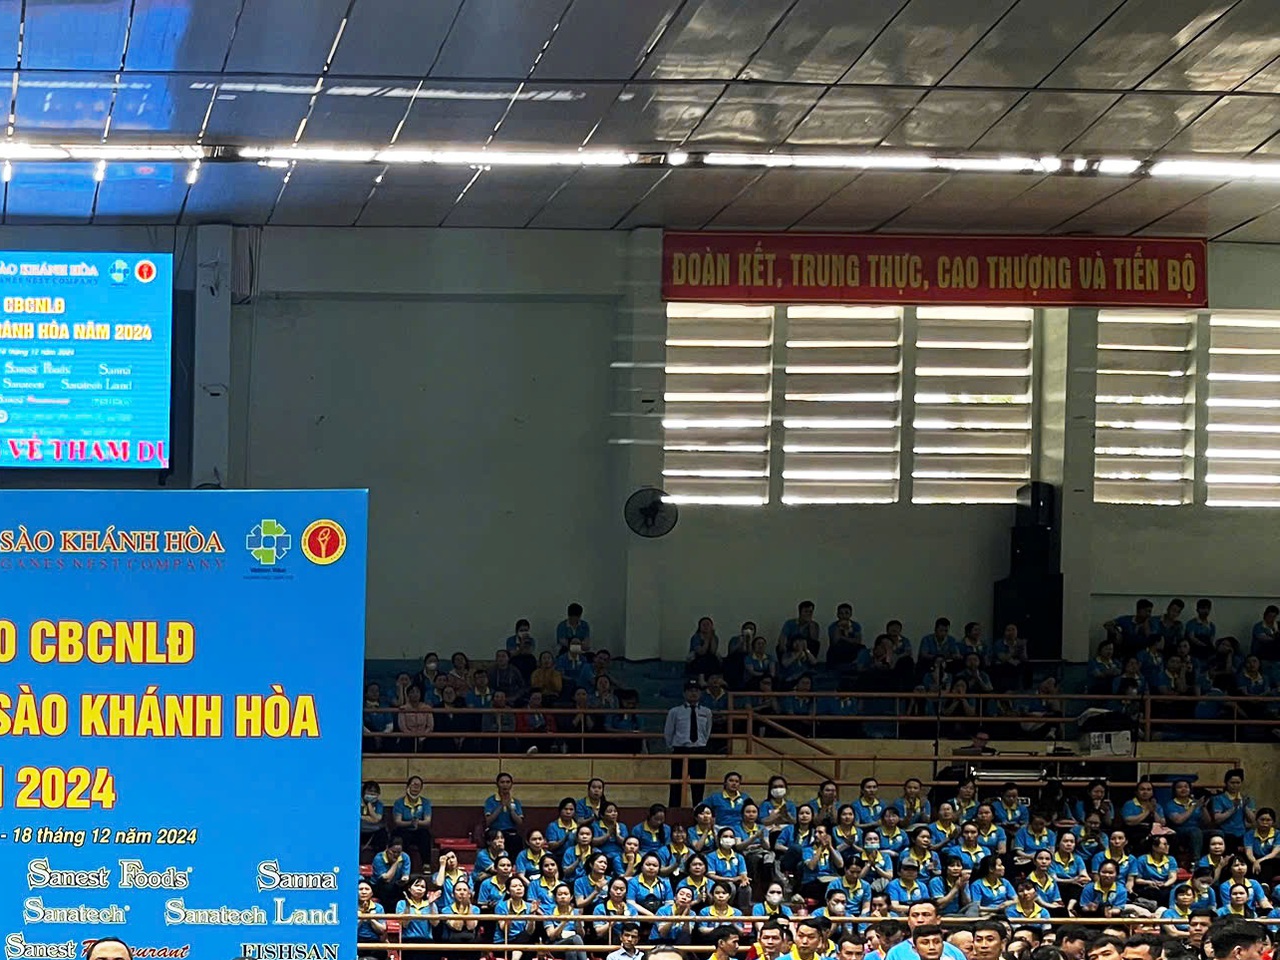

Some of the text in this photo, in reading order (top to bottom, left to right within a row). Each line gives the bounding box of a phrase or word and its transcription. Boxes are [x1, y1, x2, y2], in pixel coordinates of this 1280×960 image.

[673, 241, 1196, 299] ĐOÀN KẾT, TRUNG THỰC, CAO THƯỢNG VÀ TIẾN BỘ
[115, 324, 152, 341] 2024
[48, 440, 131, 461] THAM
[0, 525, 54, 553] SÀO
[60, 525, 159, 553] KHÁNH
[164, 525, 225, 553] HÒA
[29, 620, 196, 664] CBCNLĐ
[79, 685, 223, 738] KHÁNH
[235, 685, 319, 738] HÒA
[16, 765, 117, 810] 2024
[13, 827, 33, 844] 18
[36, 827, 86, 848] tháng
[92, 828, 111, 844] 12
[115, 828, 152, 845] năm
[156, 828, 197, 845] 2024
[27, 857, 193, 890] Sanest Foods
[257, 859, 338, 893] Sanna
[23, 896, 128, 925] Sanatech
[165, 897, 340, 926] Sanatech Land
[6, 932, 77, 960] Sanest
[241, 943, 340, 960] FISHSAN
